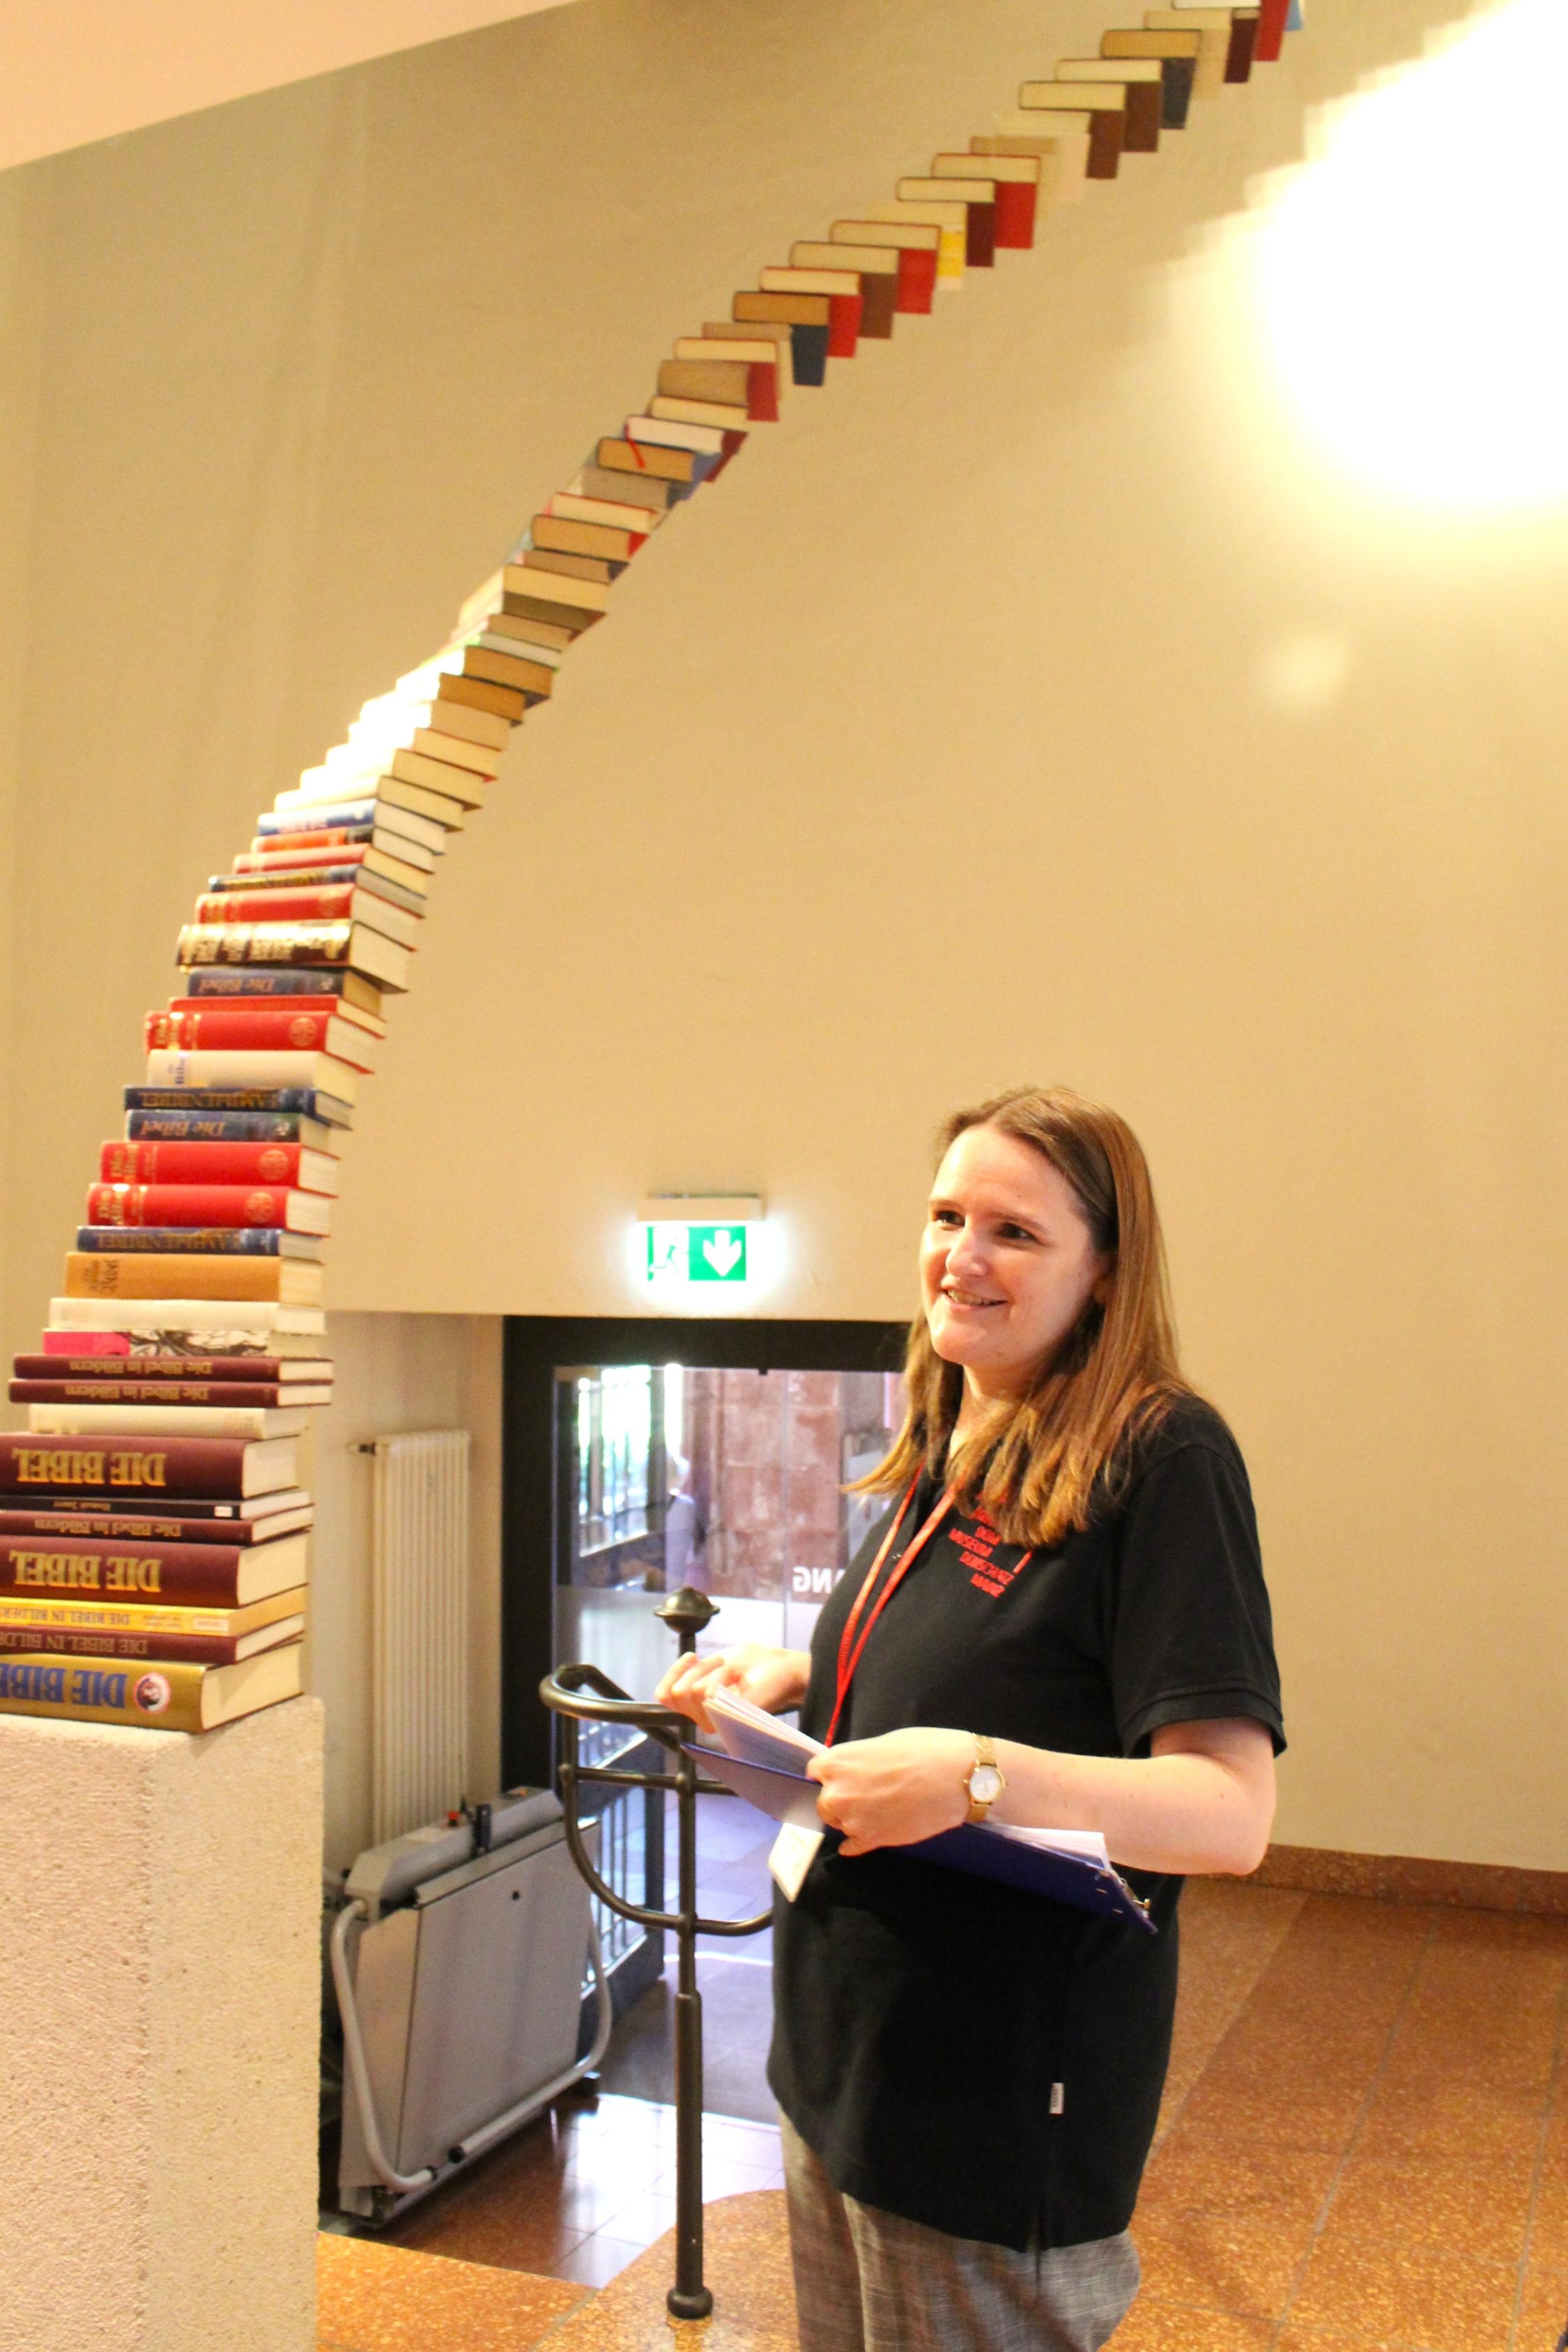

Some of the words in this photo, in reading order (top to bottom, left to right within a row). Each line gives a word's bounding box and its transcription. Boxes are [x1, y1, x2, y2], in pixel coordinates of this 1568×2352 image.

[139, 1119, 189, 1137] Bibel
[195, 1121, 225, 1137] Die
[144, 1361, 183, 1374] Bibel
[141, 1385, 180, 1400] Bibel
[12, 1448, 104, 1485] BIBEL
[109, 1452, 167, 1486] DIE
[34, 1519, 91, 1535] Bildern
[112, 1522, 151, 1537] Bibel
[154, 1523, 181, 1537] Die
[948, 1528, 994, 1558] MUSEUM
[8, 1550, 102, 1590] BIBEL
[105, 1557, 162, 1593] DIE
[52, 1610, 66, 1622] IN
[70, 1611, 105, 1624] BIBEL
[109, 1613, 130, 1625] DIE
[45, 1634, 66, 1650] IN
[70, 1636, 115, 1653] BIBEL
[119, 1639, 148, 1655] DIE
[71, 1670, 128, 1709] DIE
